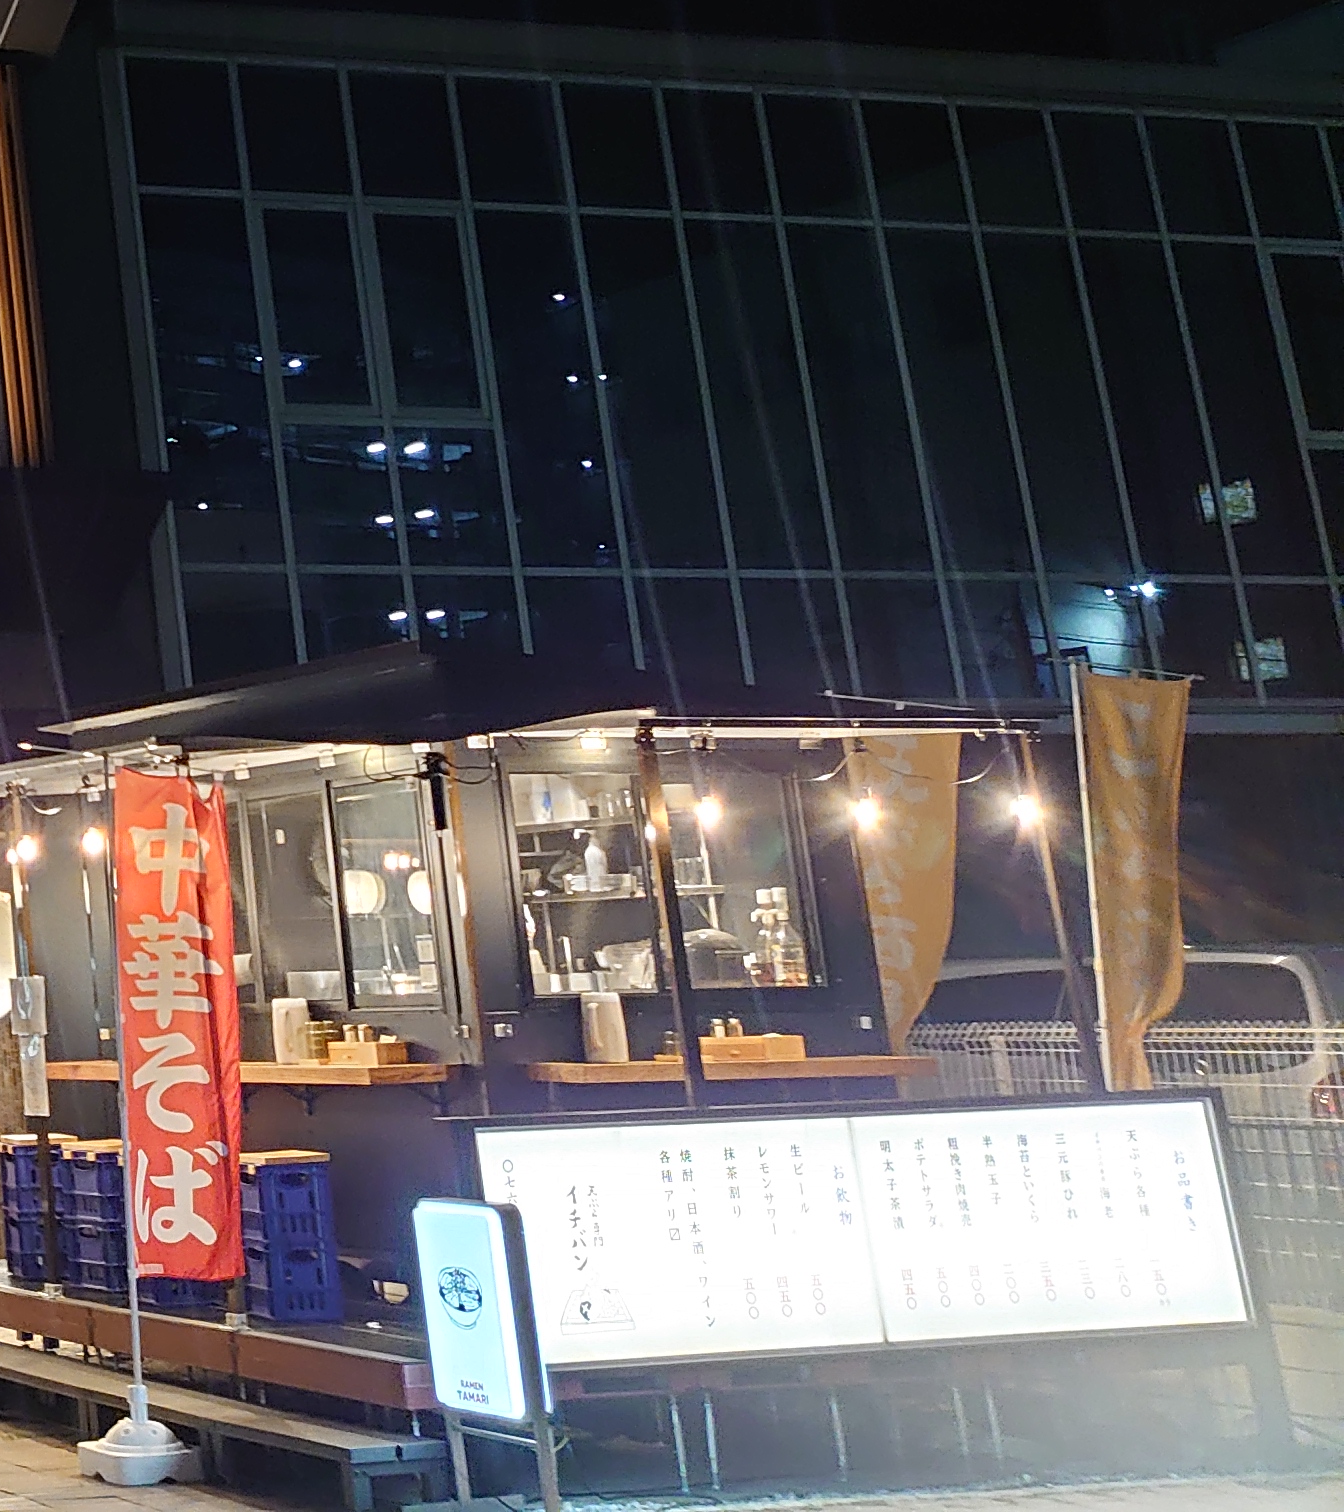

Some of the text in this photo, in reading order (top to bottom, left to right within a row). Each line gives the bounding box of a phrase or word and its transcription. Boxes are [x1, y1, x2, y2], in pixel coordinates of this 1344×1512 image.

[123, 803, 228, 1247] 中華そば
[724, 1146, 742, 1219] 抹茶割り
[758, 1145, 777, 1236] レモンサワー
[790, 1143, 810, 1215] 生ビール
[833, 1164, 853, 1226] お飲物
[879, 1140, 905, 1230] 明太子茶漬
[913, 1137, 938, 1228] ポテトサラダ
[982, 1134, 1002, 1206] 半熟玉子
[1016, 1134, 1040, 1223] 海苔といくら
[1054, 1132, 1079, 1220] 三元豚ひれ
[1125, 1129, 1151, 1217] 天ぷら各種
[1173, 1149, 1197, 1232] お品書き
[566, 1185, 588, 1272] イチバン
[456, 1390, 489, 1405] TAMARI
[460, 1379, 484, 1391] RAMEN
